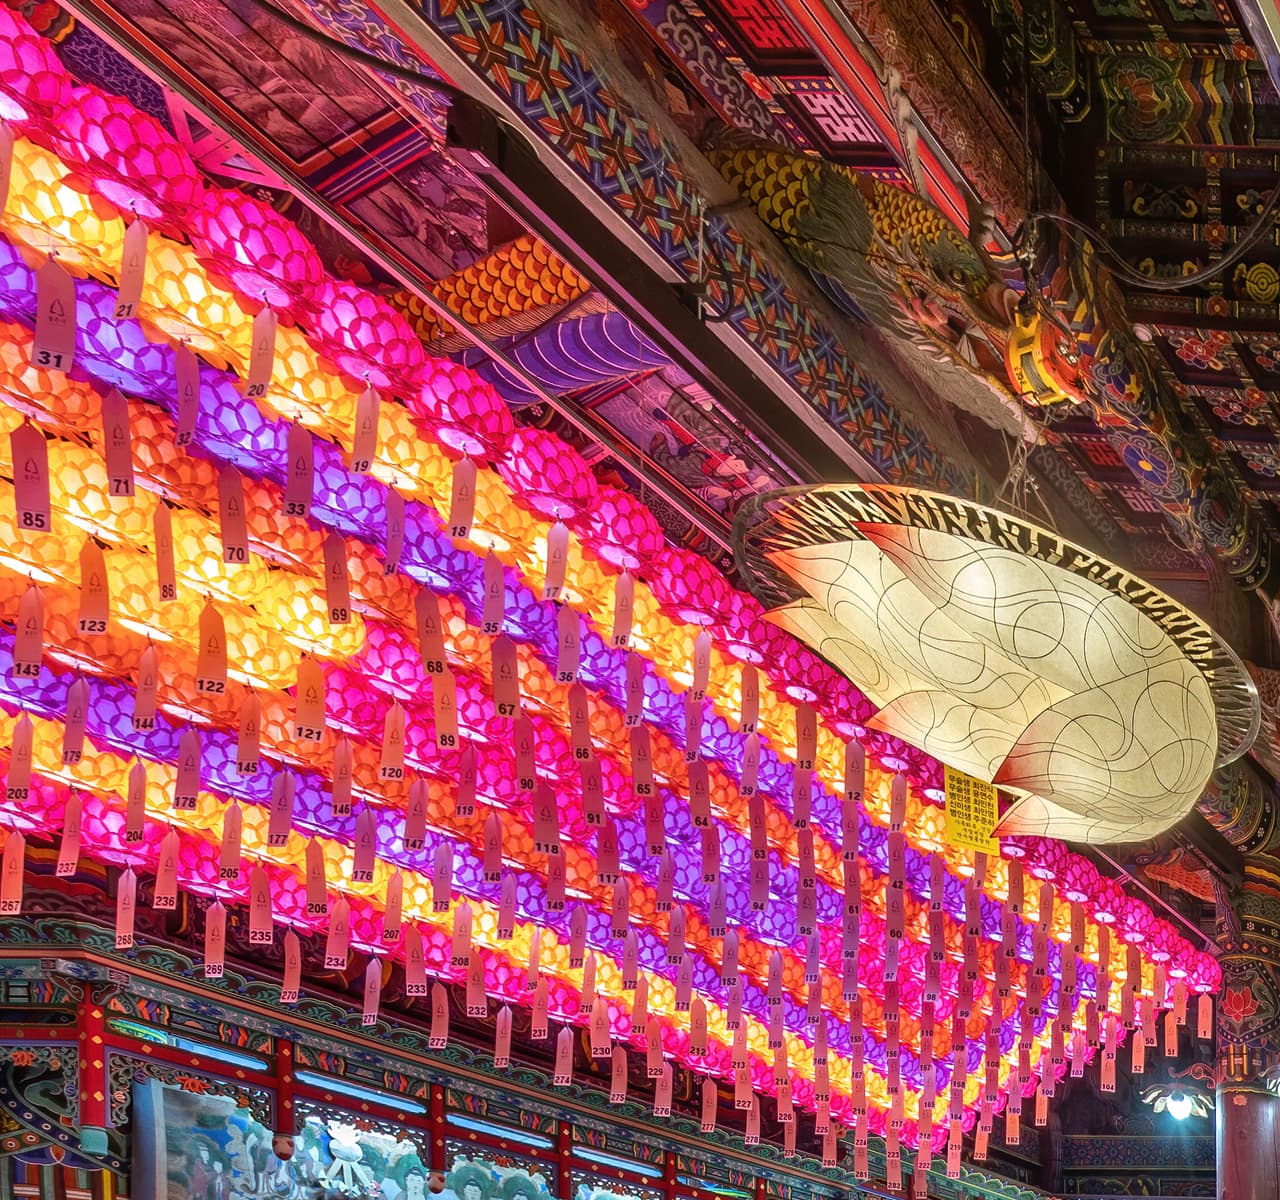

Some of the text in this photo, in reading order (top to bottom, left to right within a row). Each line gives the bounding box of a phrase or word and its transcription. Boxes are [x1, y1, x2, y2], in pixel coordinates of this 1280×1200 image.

[116, 303, 133, 317] 21
[38, 350, 63, 368] 31
[247, 383, 265, 397] 20
[177, 431, 191, 447] 32
[354, 460, 369, 472] 19
[113, 478, 129, 494] 71
[286, 502, 306, 516] 33
[23, 511, 45, 528] 85
[452, 526, 467, 537] 18
[227, 546, 245, 561] 70
[161, 583, 174, 599] 86
[546, 586, 560, 598] 17
[331, 608, 347, 621] 69
[79, 619, 106, 633] 123
[483, 622, 499, 633] 35
[15, 662, 40, 677] 143
[427, 660, 443, 673] 68
[559, 672, 574, 683] 36
[197, 679, 225, 693] 122
[498, 703, 516, 716] 67
[135, 717, 154, 730] 144
[626, 714, 639, 726] 37
[296, 726, 322, 741] 121
[440, 734, 455, 747] 89
[575, 747, 589, 759] 66
[237, 761, 258, 773] 145
[799, 759, 812, 770] 13
[381, 766, 403, 779] 120
[7, 787, 29, 800] 203
[636, 783, 651, 795] 65
[174, 796, 196, 808] 178
[847, 791, 861, 801] 12
[333, 804, 352, 815] 146
[587, 812, 601, 825] 91
[694, 815, 708, 827] 64
[793, 819, 807, 829] 40
[125, 830, 144, 842] 204
[268, 833, 289, 845] 177
[404, 838, 425, 850] 147
[535, 842, 559, 855] 118
[754, 849, 766, 860] 63
[58, 863, 75, 874] 237
[219, 867, 239, 879] 205
[353, 869, 373, 881] 176
[802, 878, 814, 888] 62
[1, 900, 20, 911] 267
[156, 896, 175, 906] 236
[307, 902, 327, 914] 206
[251, 930, 272, 942] 235
[889, 928, 903, 939] 60
[116, 934, 133, 946] 268
[326, 957, 345, 967] 234
[206, 964, 222, 974] 269
[407, 984, 426, 994] 233
[280, 990, 298, 1001] 270
[468, 1006, 486, 1016] 232
[430, 1036, 447, 1048] 272
[592, 1046, 611, 1056] 230
[1133, 1064, 1143, 1072] 52
[736, 1100, 752, 1110] 227
